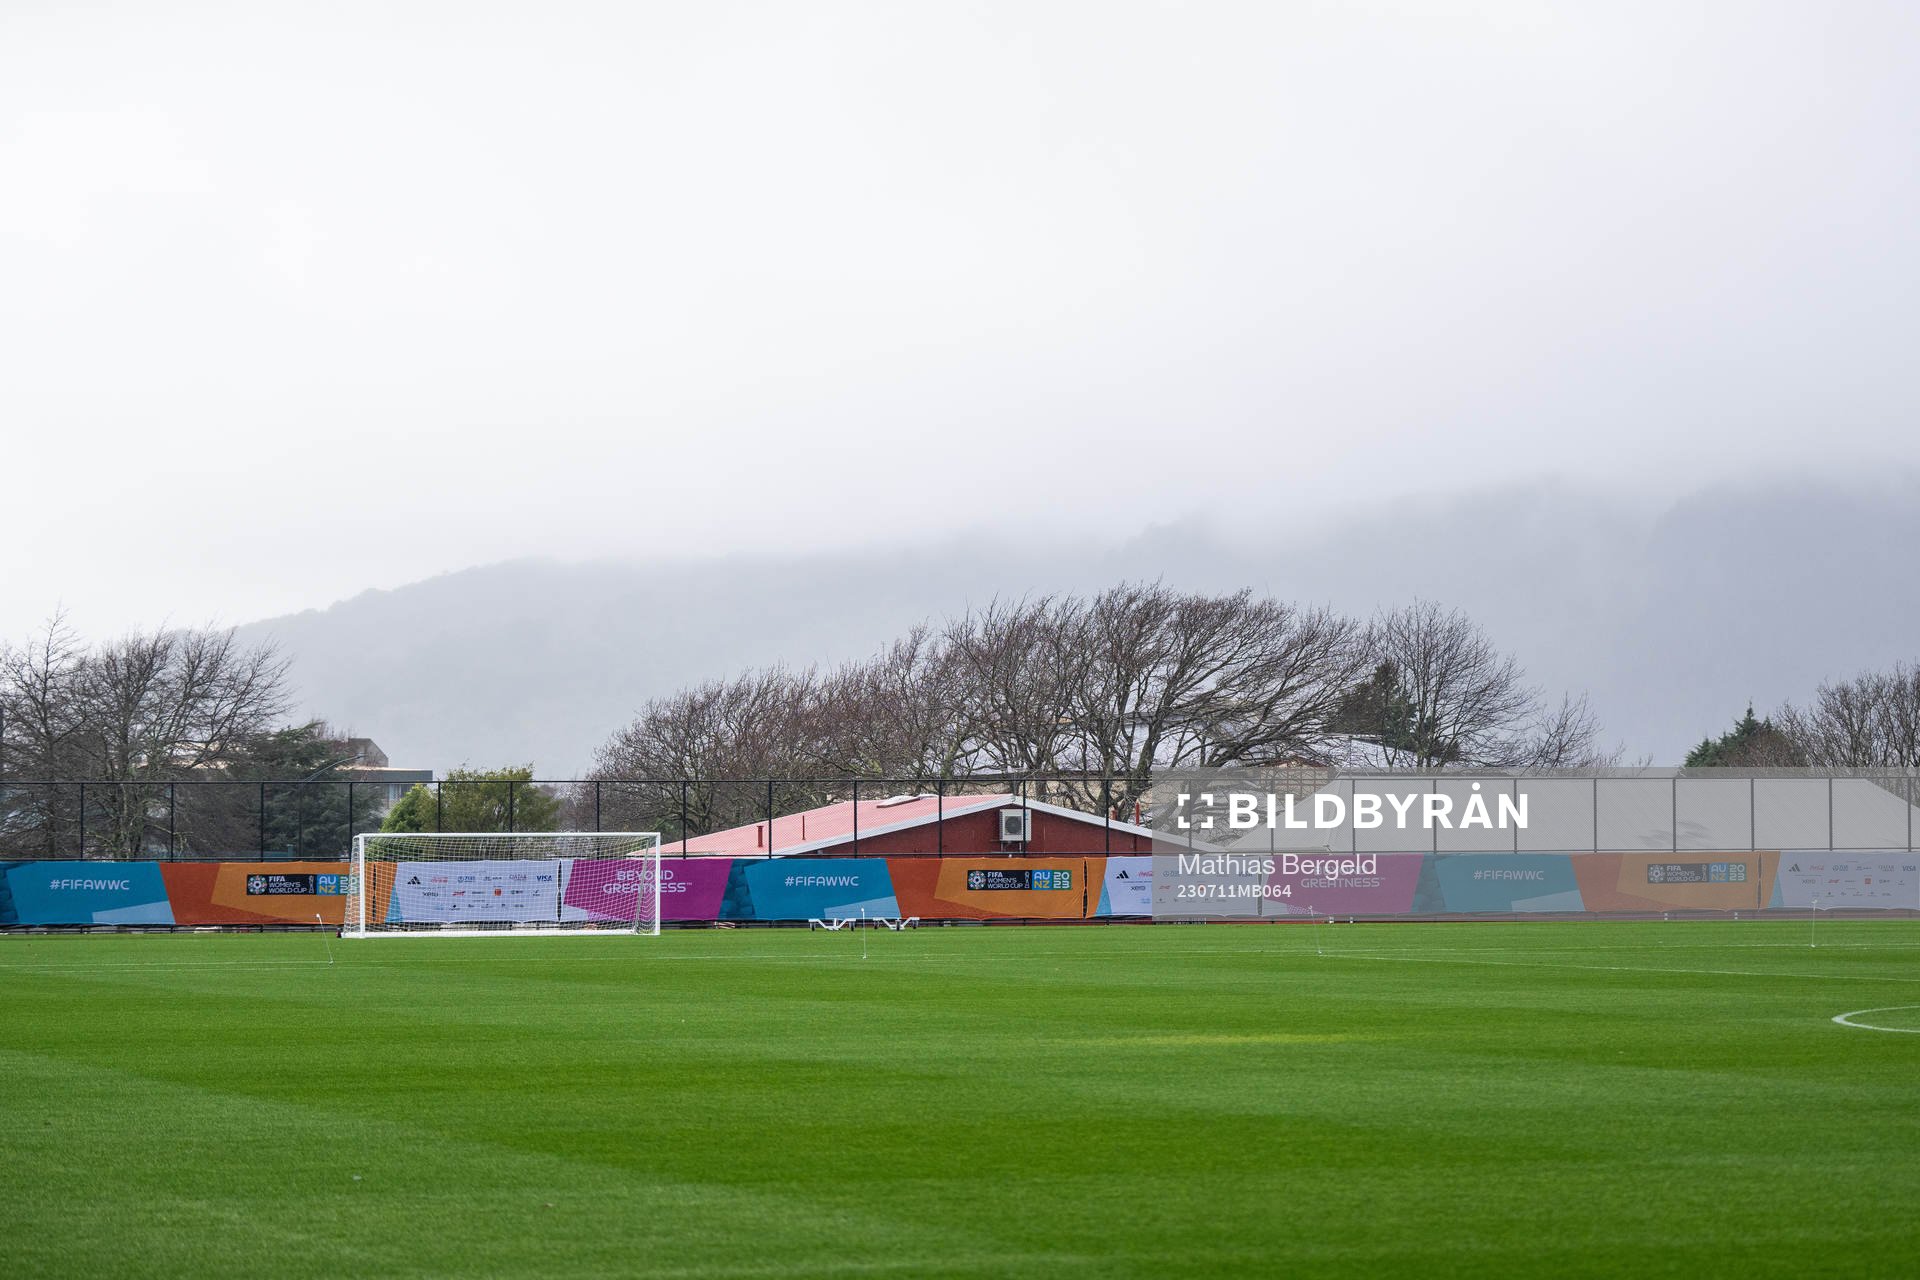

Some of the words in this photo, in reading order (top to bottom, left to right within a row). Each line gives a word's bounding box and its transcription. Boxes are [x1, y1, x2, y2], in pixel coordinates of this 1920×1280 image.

[1711, 865, 1727, 873] AU
[1729, 864, 1745, 873] 20
[1034, 872, 1051, 880] AU
[1053, 872, 1070, 880] 20
[1473, 870, 1545, 880] #FIFAWWC
[1711, 873, 1726, 881] NZ
[1729, 873, 1745, 881] 23
[50, 879, 130, 890] #FIFAWWC
[318, 876, 337, 885] AU
[784, 876, 860, 887] #FIFAWWC
[1033, 880, 1050, 889] NZ
[1053, 880, 1070, 889] 23
[318, 885, 336, 894] NZ
